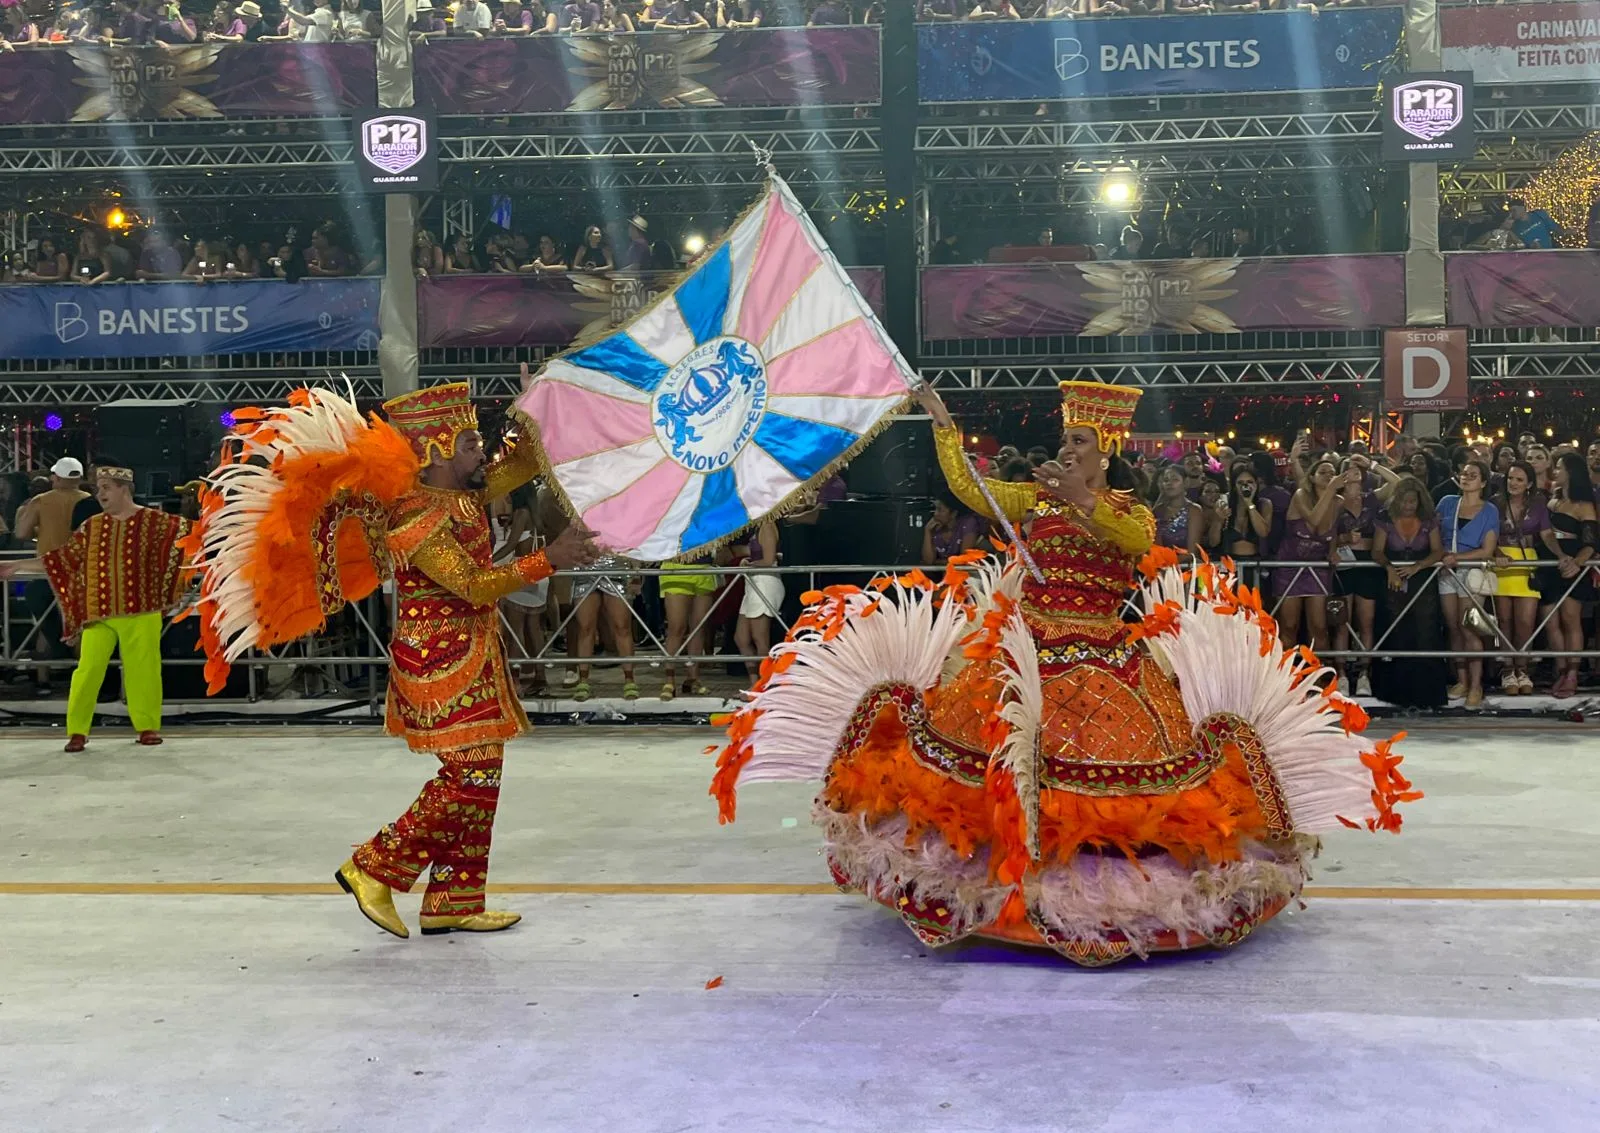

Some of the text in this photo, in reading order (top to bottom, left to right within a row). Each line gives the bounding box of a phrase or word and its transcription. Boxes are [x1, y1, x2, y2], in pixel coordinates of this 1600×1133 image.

[1517, 19, 1600, 40] CARNAVA
[645, 53, 675, 70] P12
[1100, 39, 1261, 72] BANESTES
[1518, 49, 1561, 67] FEITA
[146, 65, 176, 80] P12
[609, 59, 637, 72] MA
[1403, 88, 1454, 110] P12
[1404, 108, 1453, 118] PARADOR
[371, 124, 418, 144] P12
[372, 143, 417, 151] PARADOR
[1160, 280, 1192, 296] P12
[99, 305, 249, 336] BANESTES
[1407, 332, 1445, 343] SETOR
[1402, 346, 1451, 399] D
[681, 450, 729, 471] NOVO
[909, 514, 923, 528] 18
